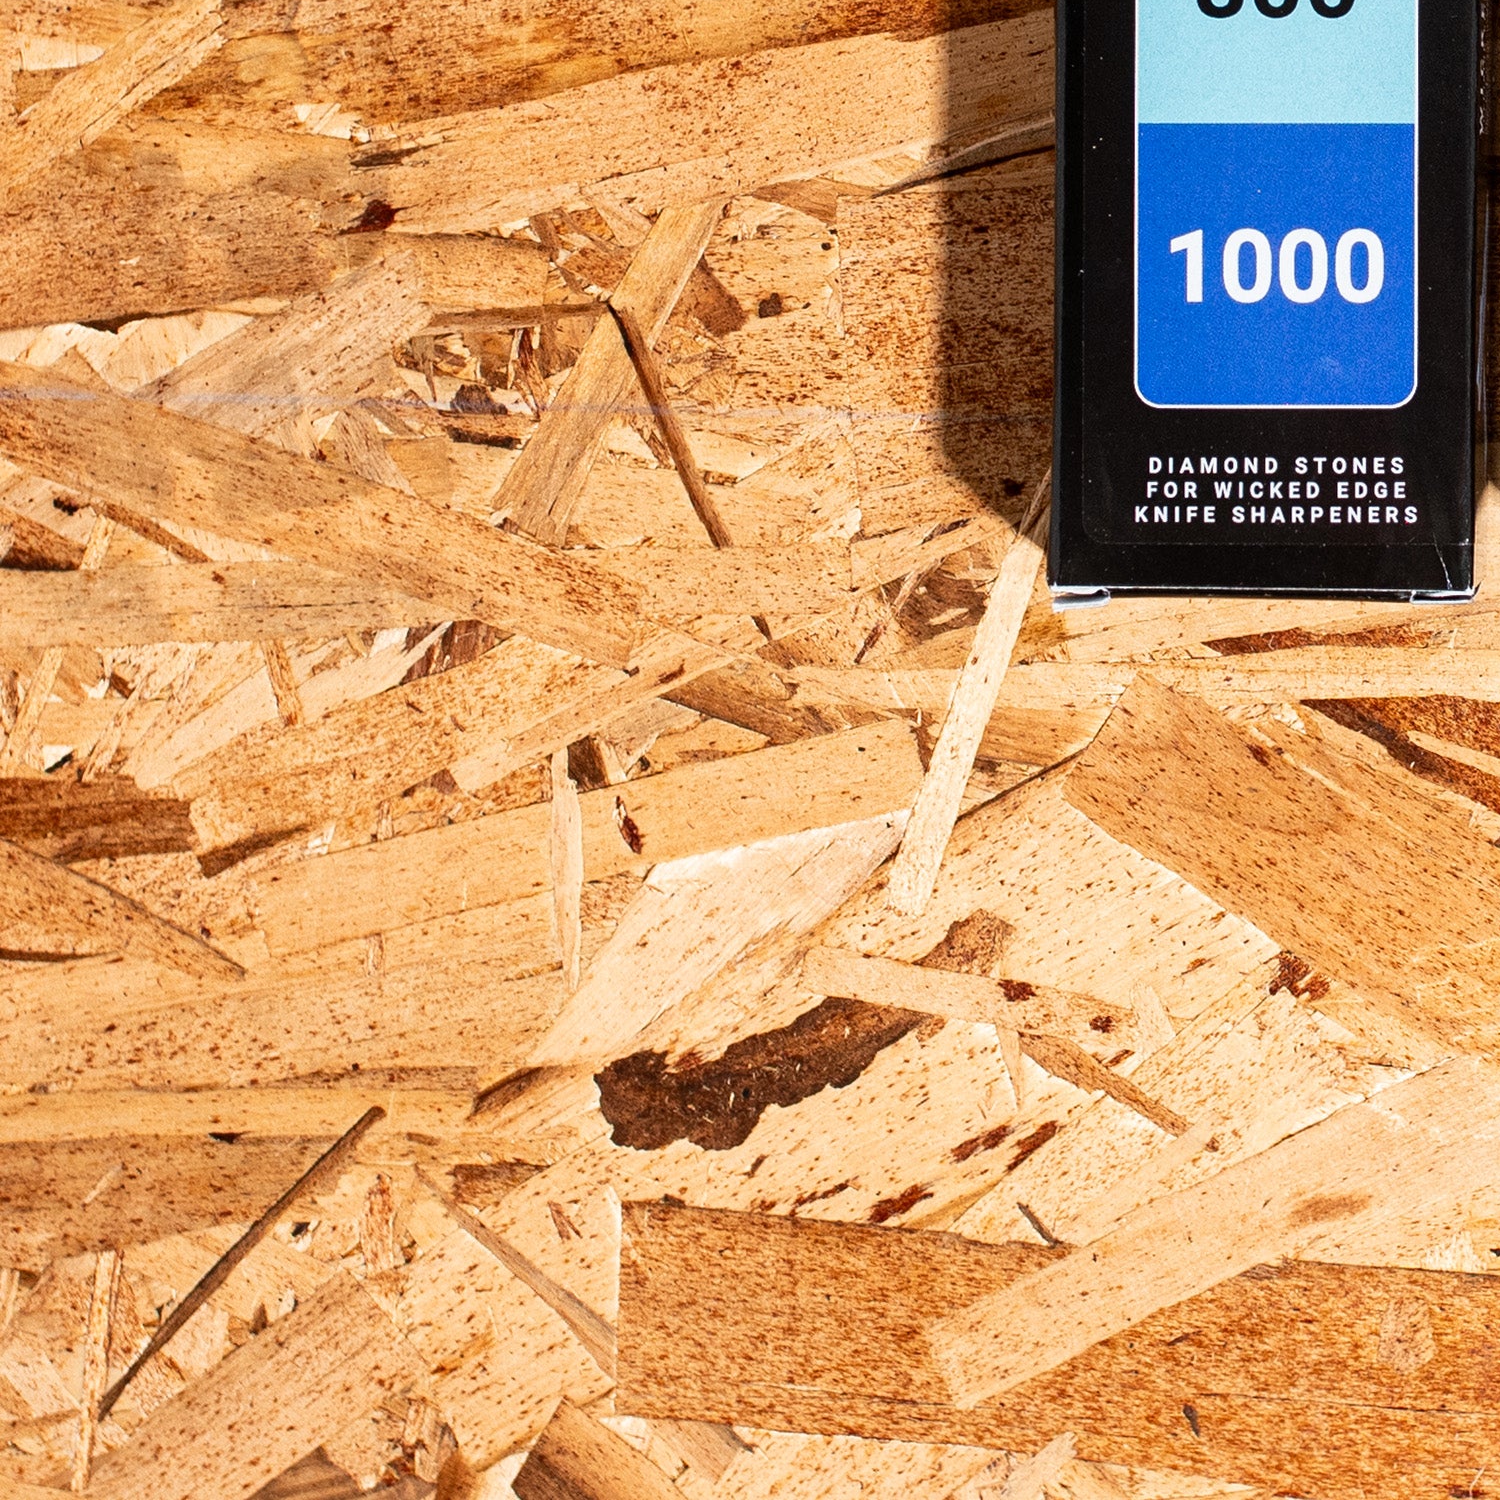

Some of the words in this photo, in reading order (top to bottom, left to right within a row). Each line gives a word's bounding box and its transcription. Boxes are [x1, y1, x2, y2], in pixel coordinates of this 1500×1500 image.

[1169, 227, 1386, 304] 1000
[1148, 456, 1278, 475] DIAMOND
[1294, 456, 1405, 476] STONES
[1146, 481, 1198, 500] FOR
[1213, 481, 1320, 500] WICKED
[1336, 481, 1407, 500] EDGE
[1134, 505, 1217, 524] KNIFE
[1231, 505, 1419, 525] SHARPENERS
